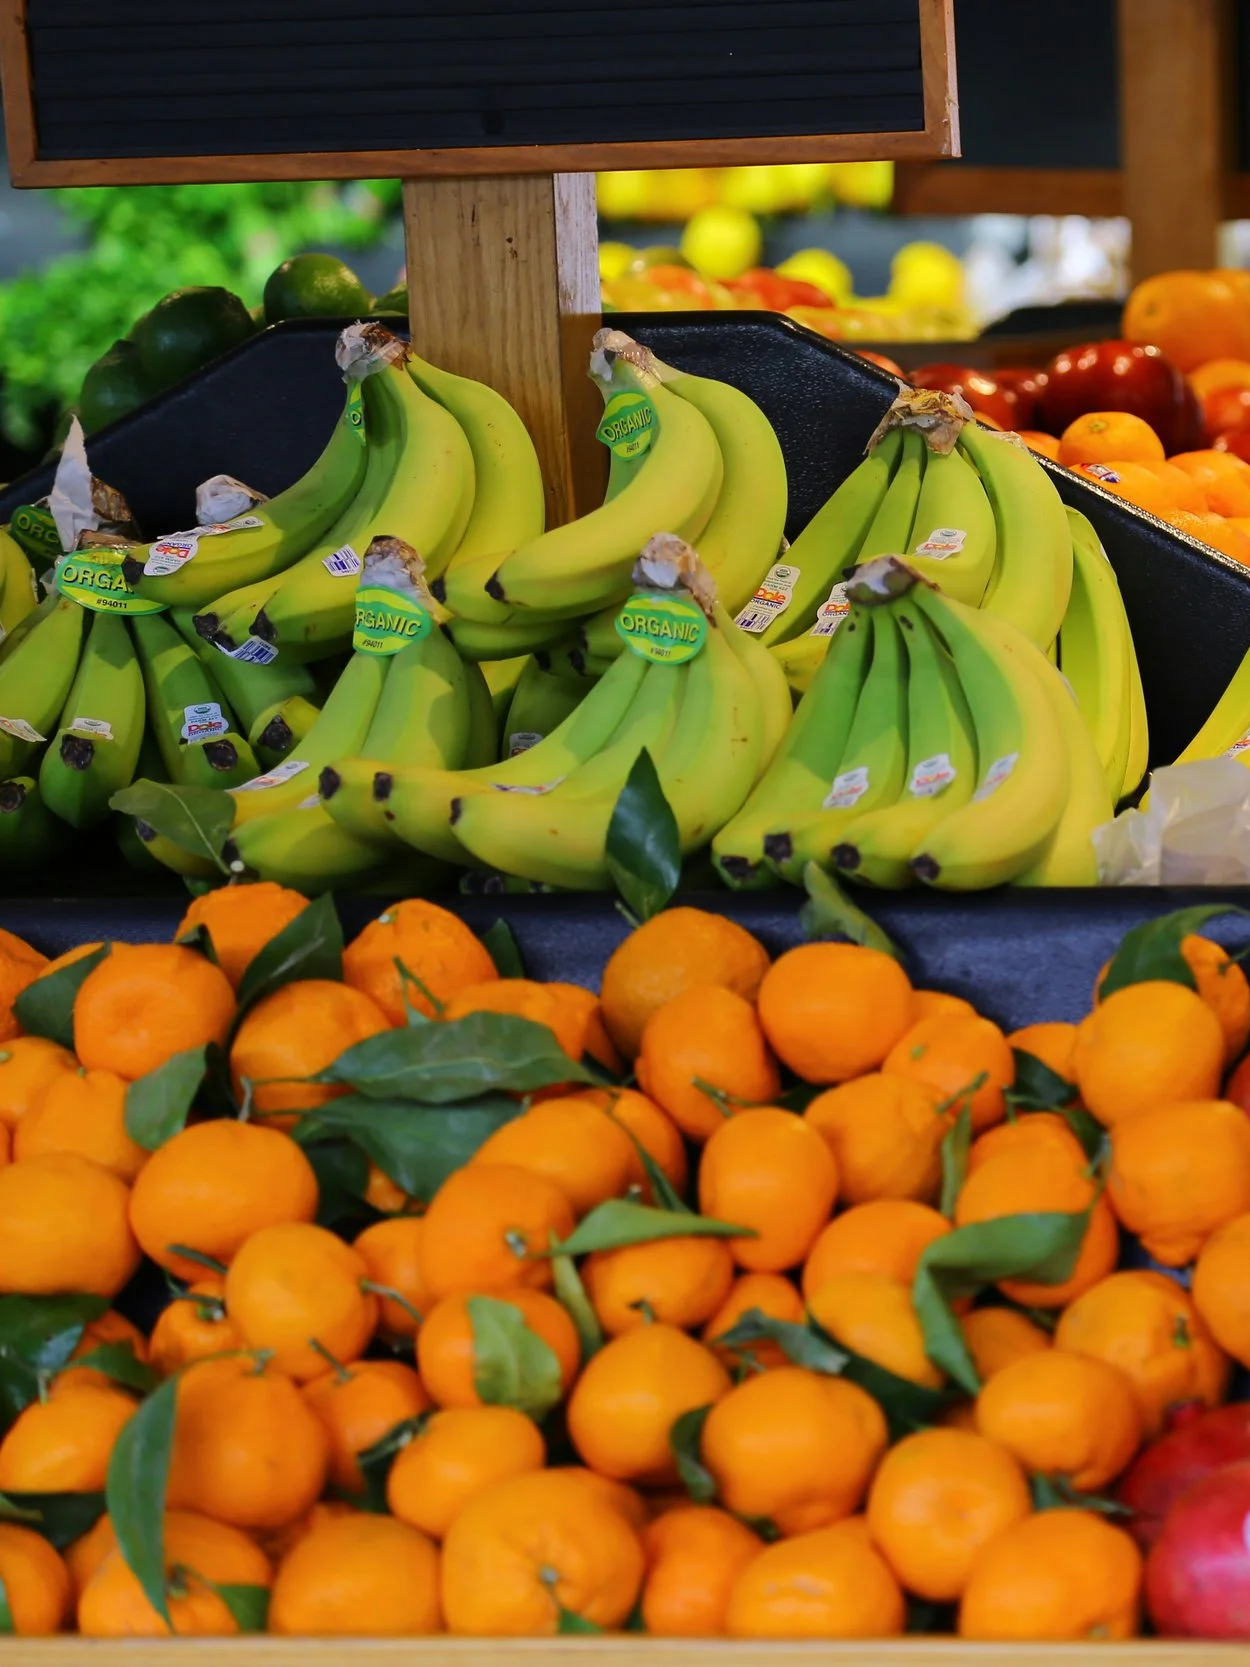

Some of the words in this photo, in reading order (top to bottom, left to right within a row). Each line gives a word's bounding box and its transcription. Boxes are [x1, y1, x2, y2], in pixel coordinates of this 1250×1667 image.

[601, 406, 652, 442] ORGANIC
[156, 547, 190, 558] Dole
[61, 564, 135, 594] ORGA
[754, 587, 787, 602] Dole
[96, 599, 128, 609] #94011
[751, 598, 781, 609] ORGANIC
[825, 603, 851, 612] Dol
[355, 608, 422, 637] RGANIC
[620, 613, 700, 643] ORGANIC
[188, 721, 223, 732] Dole
